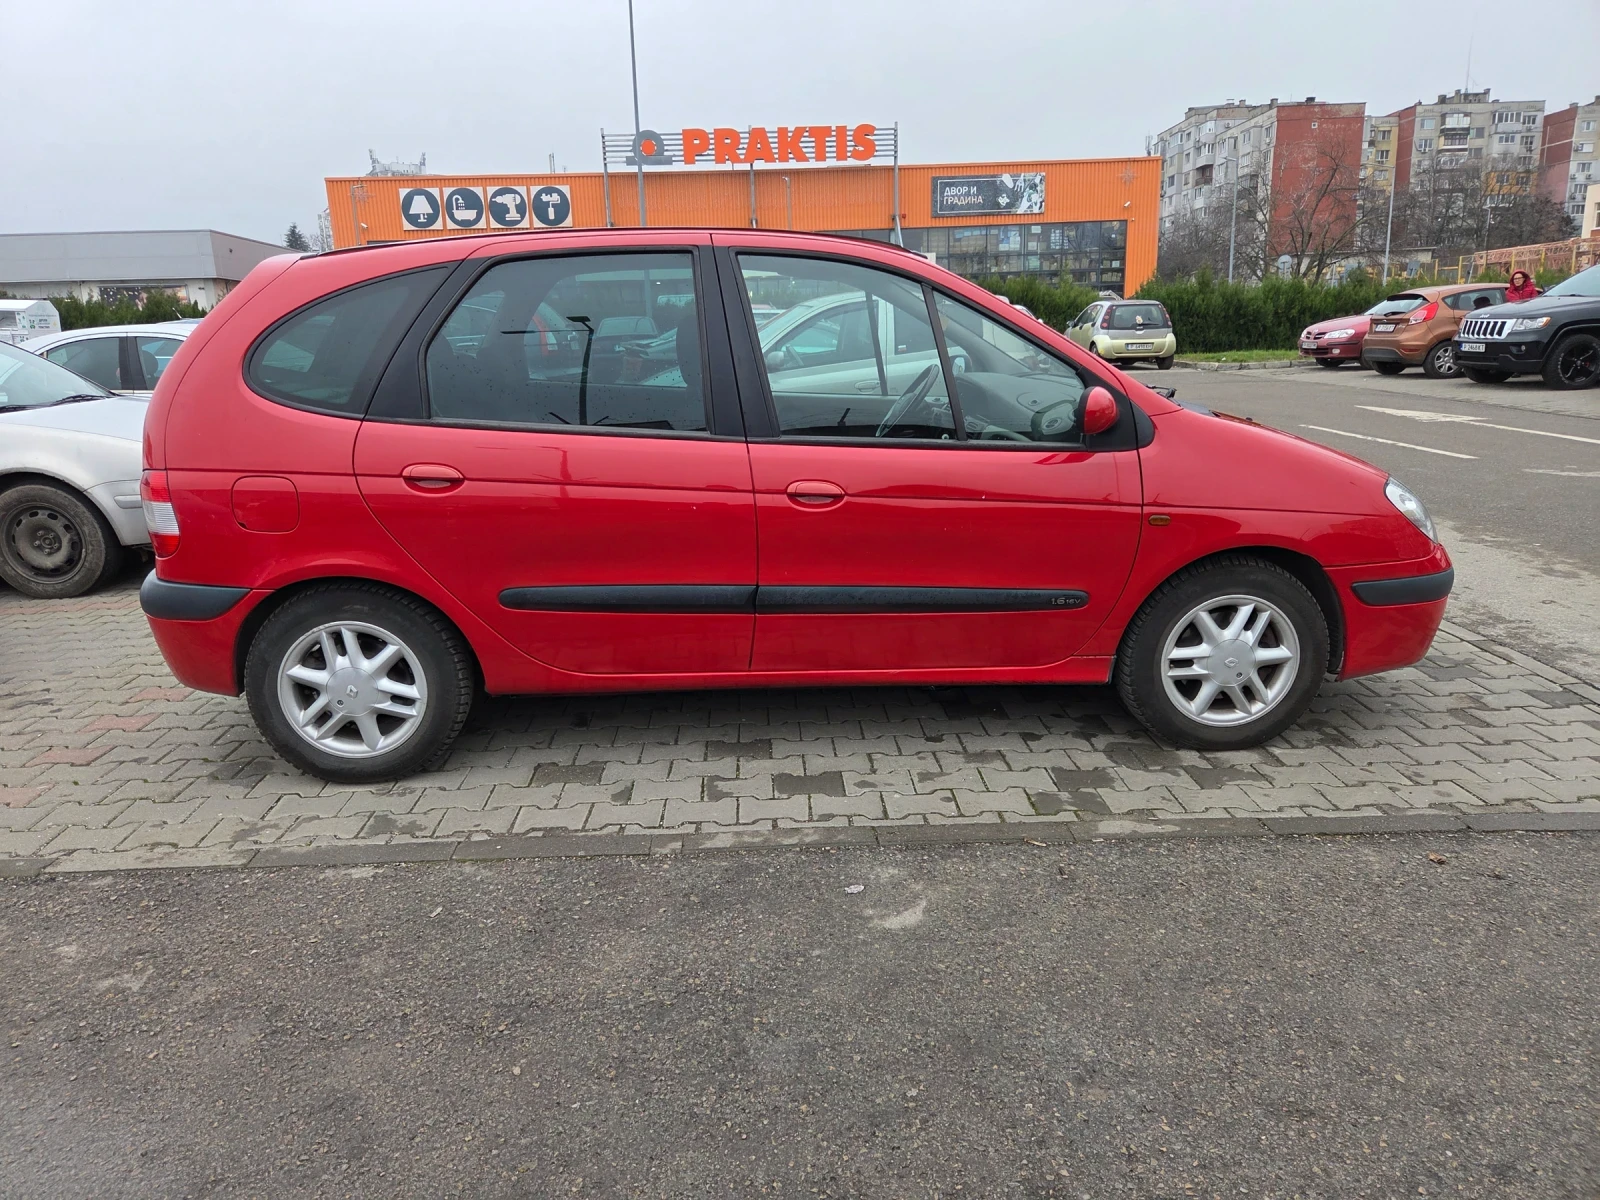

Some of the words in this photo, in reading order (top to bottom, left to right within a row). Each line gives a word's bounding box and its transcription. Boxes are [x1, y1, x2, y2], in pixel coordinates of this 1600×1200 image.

[682, 123, 877, 165] PRAKTIS
[944, 186, 968, 196] ДВОР
[970, 186, 977, 195] И
[943, 195, 983, 206] ГРАДИНА
